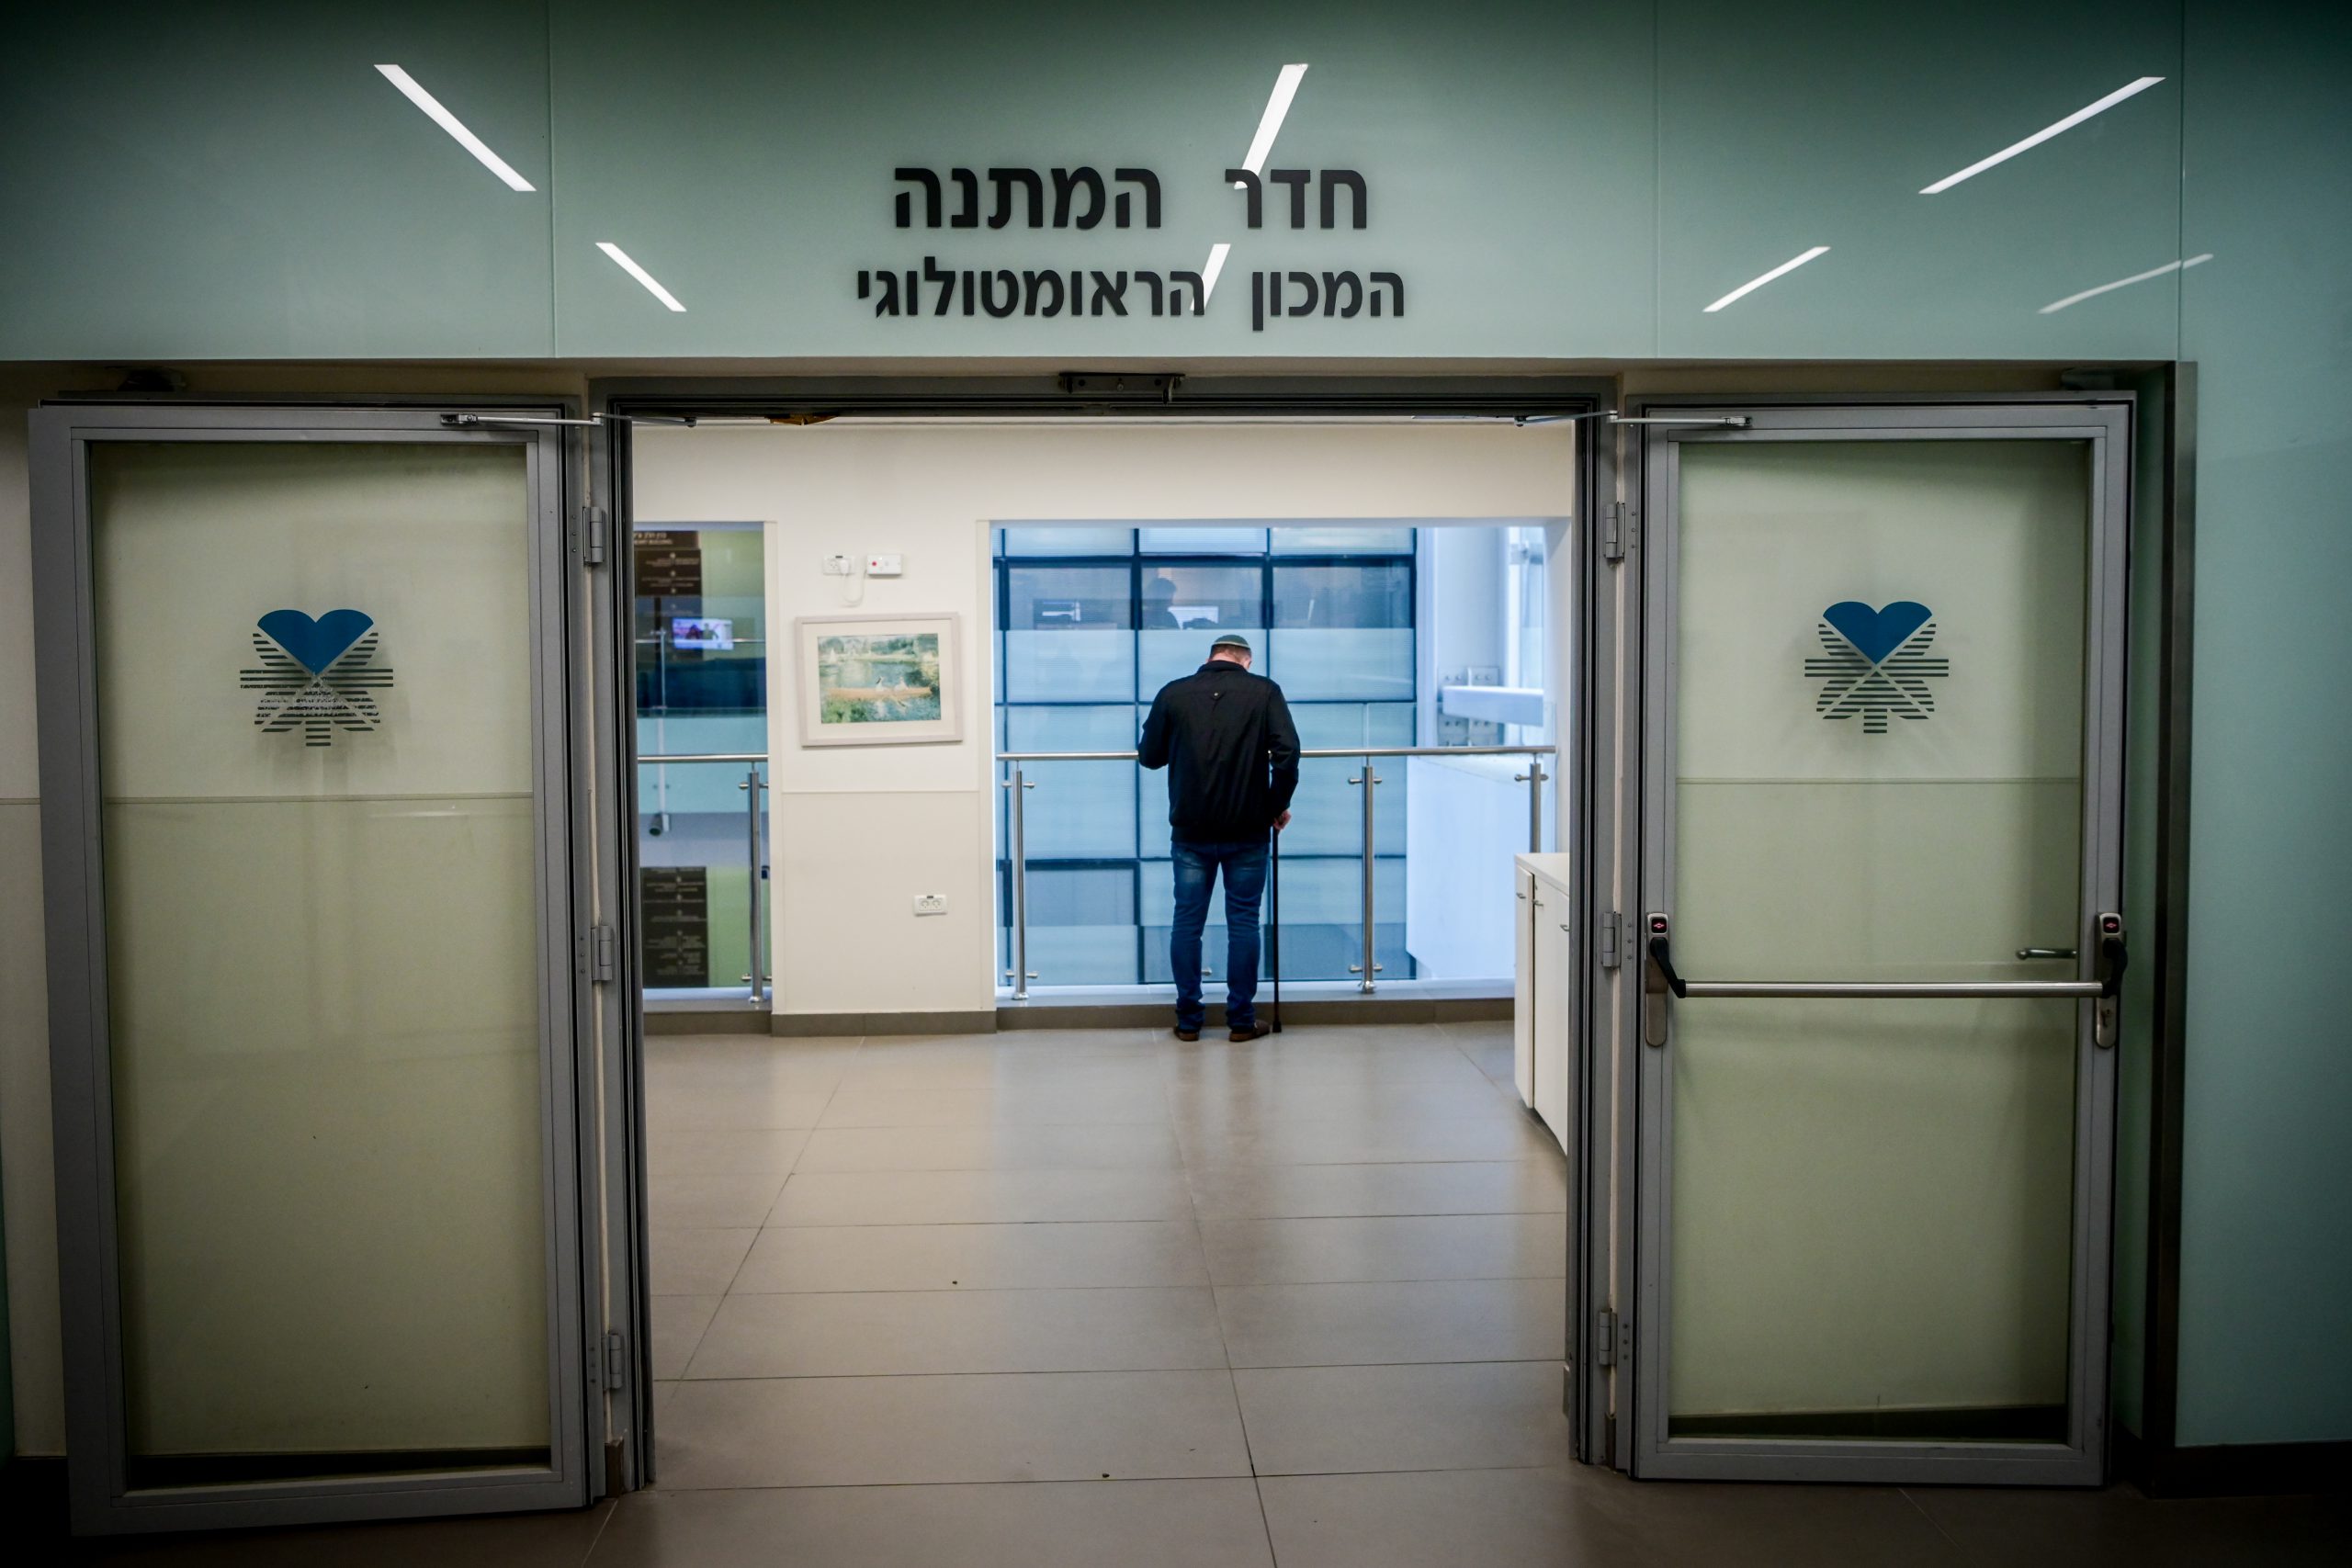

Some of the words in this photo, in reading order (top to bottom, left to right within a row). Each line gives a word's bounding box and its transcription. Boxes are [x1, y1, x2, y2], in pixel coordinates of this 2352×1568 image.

[894, 166, 1161, 230] המתנה
[1226, 169, 1367, 229] חדר
[857, 256, 1204, 318] הראומטולוגי
[1252, 271, 1405, 331] המכון
